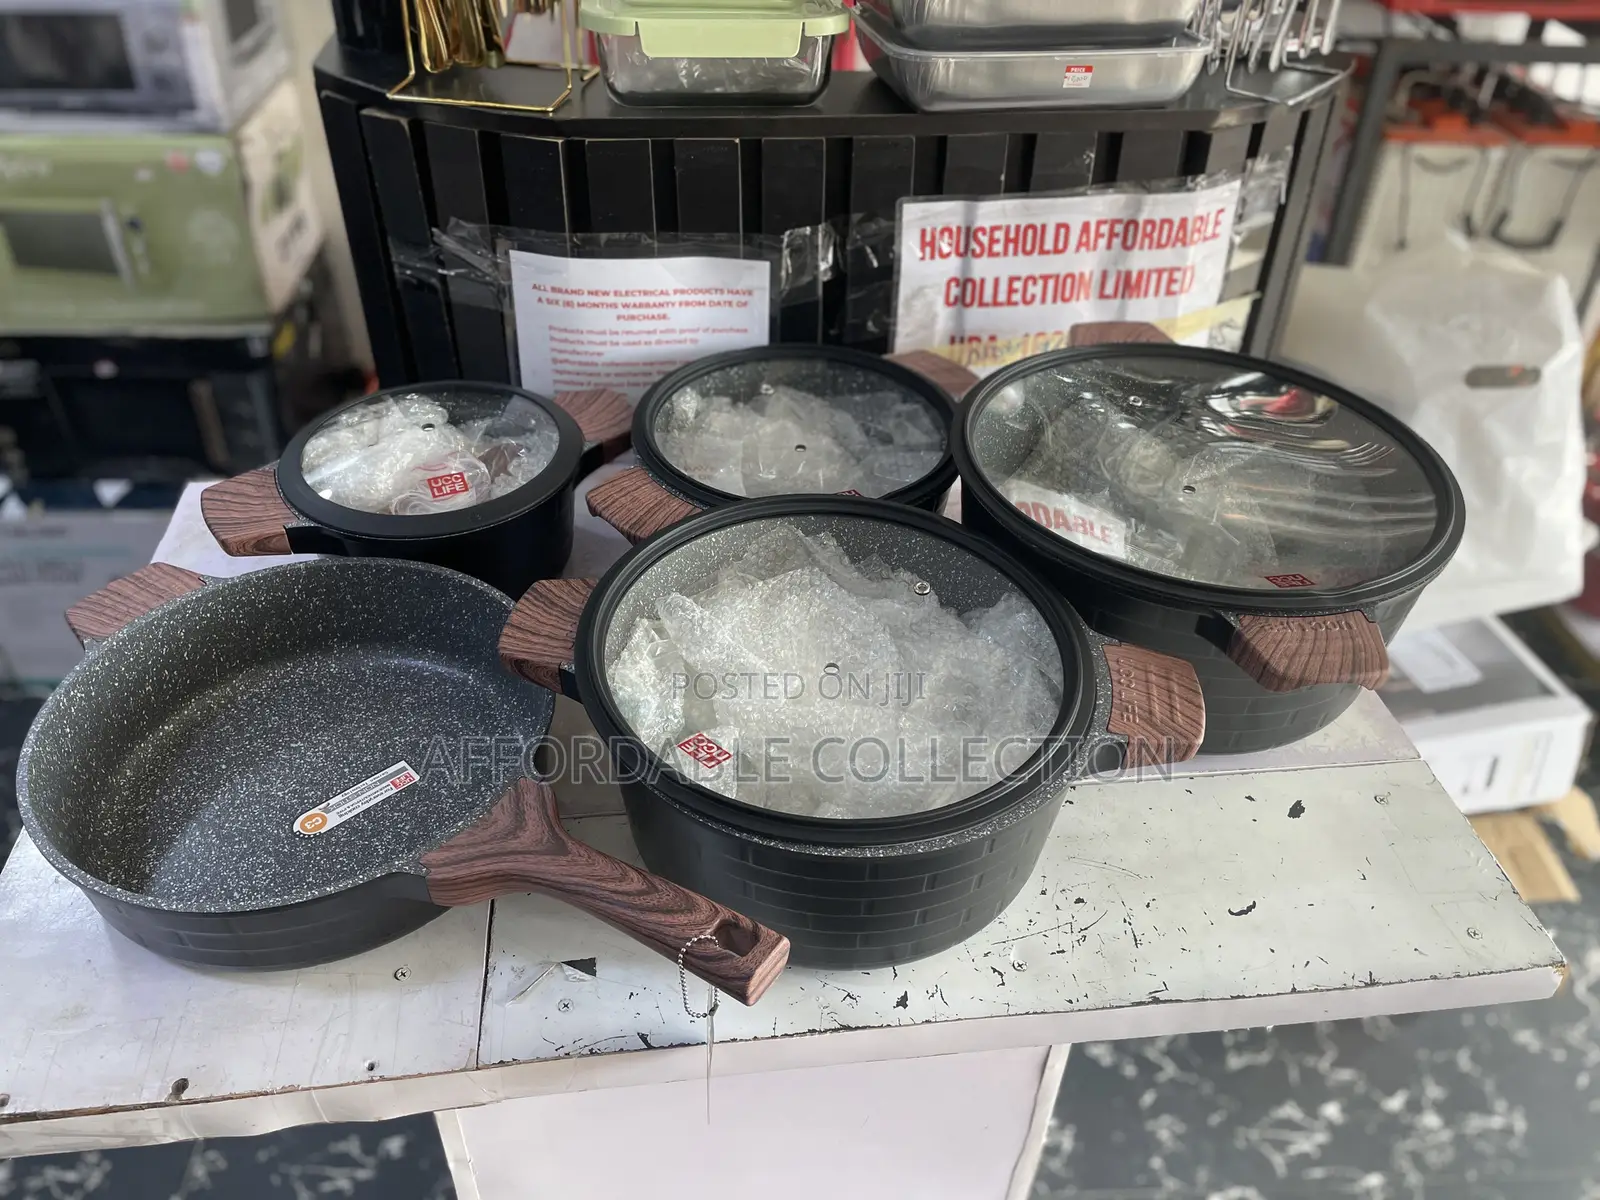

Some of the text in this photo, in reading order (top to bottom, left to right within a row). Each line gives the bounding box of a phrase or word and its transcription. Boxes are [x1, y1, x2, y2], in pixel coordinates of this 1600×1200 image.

[919, 208, 1226, 261] HOUSEHOLD AFFORDABLE
[532, 283, 548, 292] ALL
[550, 286, 584, 295] BRAND
[614, 289, 670, 297] ELECTRICAL
[673, 288, 724, 296] PRODUCTS
[727, 288, 753, 296] HAVE
[944, 266, 1195, 308] COLLECTION LIMITED
[577, 301, 618, 309] MONTHS
[621, 301, 676, 309] WARRANTY
[678, 300, 706, 308] FROM
[709, 300, 733, 308] DATE
[616, 313, 670, 321] PURCHASE.
[431, 474, 462, 487] UCC
[433, 482, 465, 496] LIFE
[304, 816, 323, 830] C3
